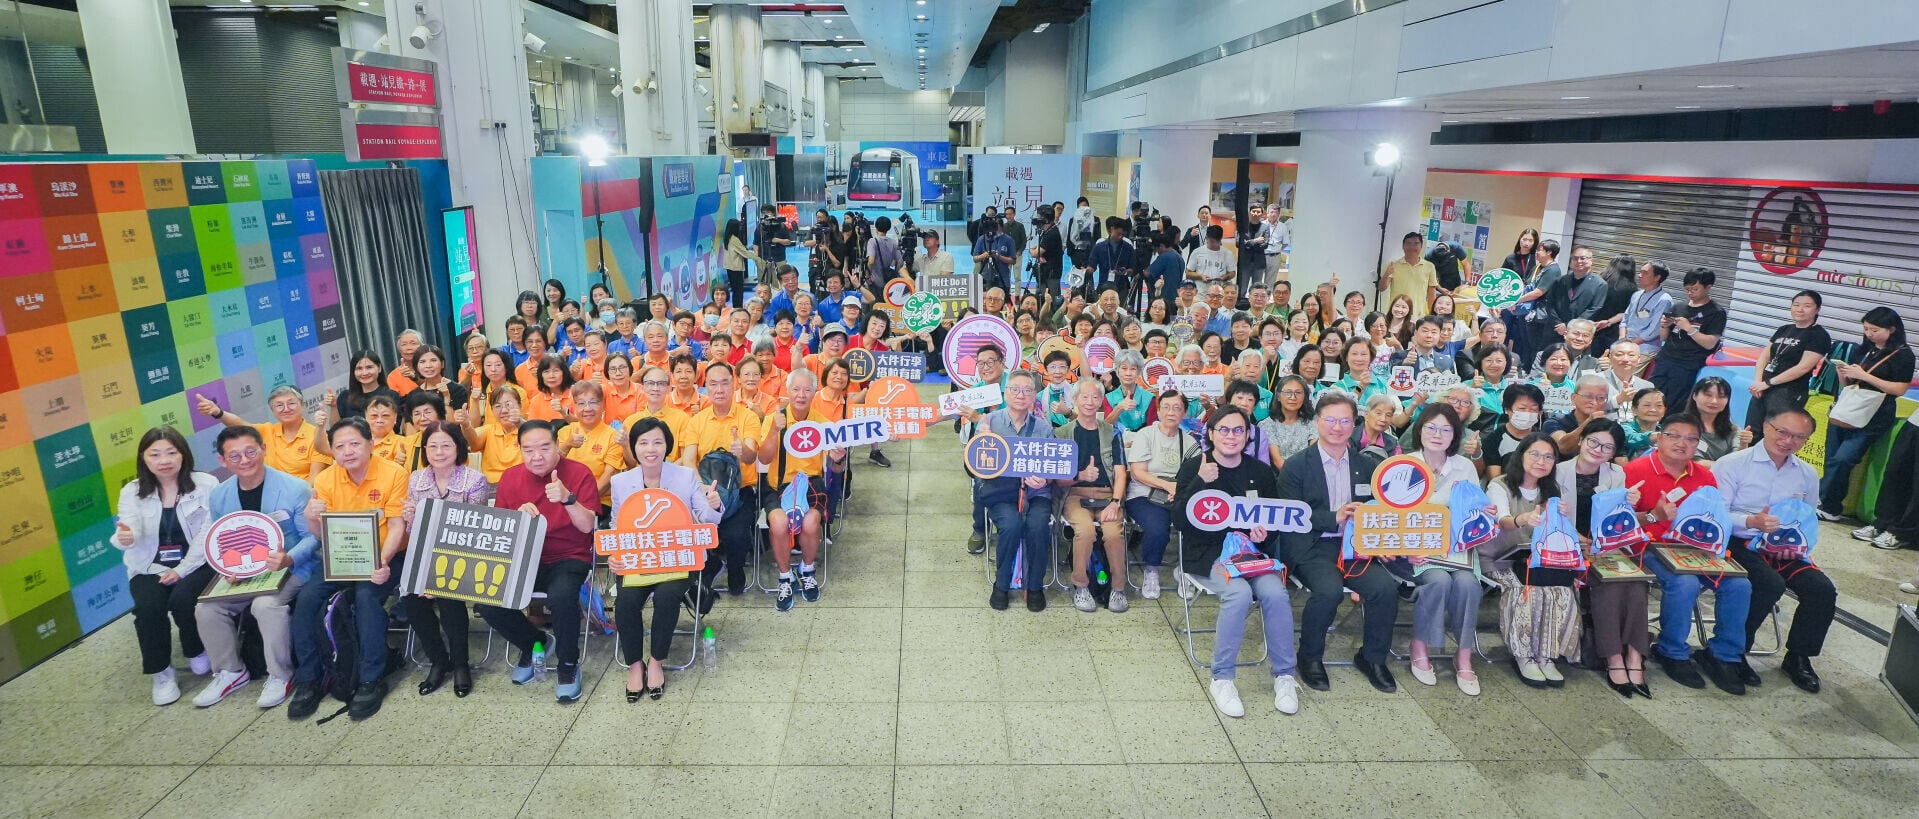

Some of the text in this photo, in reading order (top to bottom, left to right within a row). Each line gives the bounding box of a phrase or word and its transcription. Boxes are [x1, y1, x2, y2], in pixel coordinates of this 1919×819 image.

[928, 151, 948, 162] 車長
[1005, 166, 1033, 181] 載遇
[992, 185, 1044, 212] 站見
[948, 287, 968, 297] 企定
[877, 354, 922, 368] 大件行李
[824, 420, 884, 445] MTR
[1013, 440, 1073, 458] 大件行李
[482, 513, 502, 531] Do
[503, 517, 516, 533] it
[1234, 503, 1306, 527] MTR
[1361, 511, 1444, 530] 扶定 企定
[440, 528, 512, 554] Just 企定
[600, 527, 713, 552] 港鐵扶手電梯
[1361, 532, 1443, 550] 安全要緊
[622, 549, 696, 570] 安全運動
